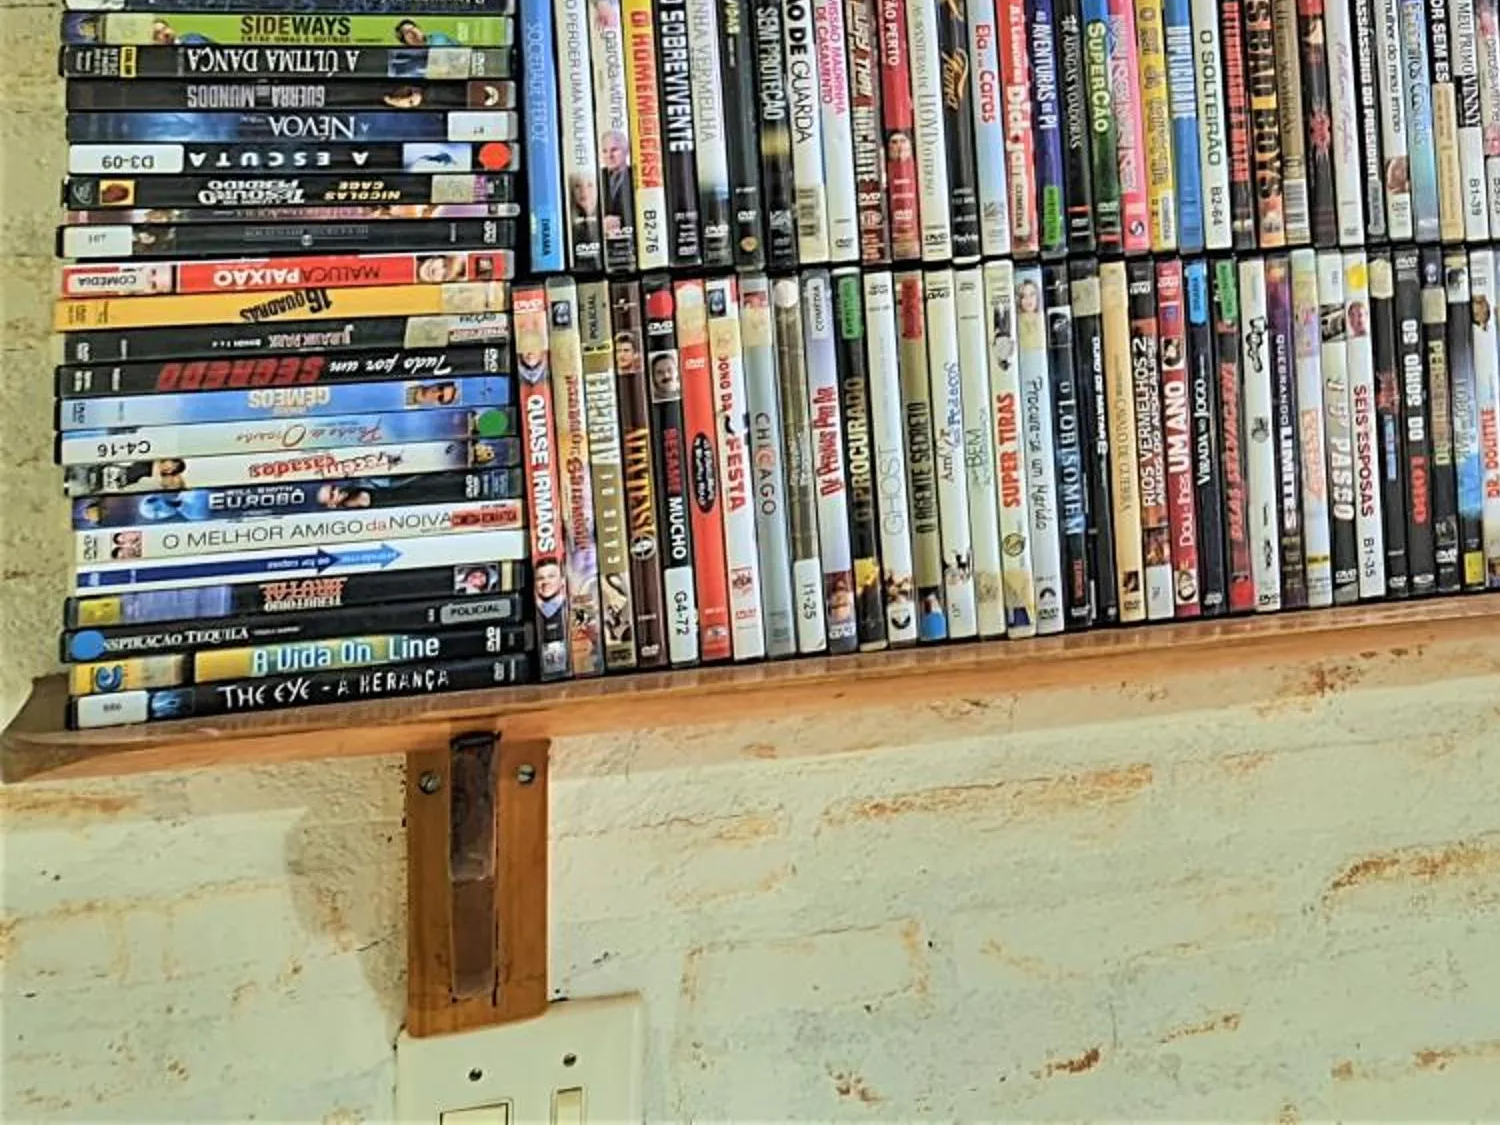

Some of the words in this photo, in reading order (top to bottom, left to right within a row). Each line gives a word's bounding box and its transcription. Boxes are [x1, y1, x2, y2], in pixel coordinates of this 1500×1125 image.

[240, 16, 351, 36] SIDEWAYS
[566, 13, 582, 68] PERDER
[755, 7, 777, 44] SEM
[789, 26, 809, 57] DE
[1199, 30, 1214, 45] O
[1433, 22, 1446, 57] SEM
[188, 47, 264, 73] DANÇA
[267, 48, 340, 74] ÚLTIMA
[344, 50, 360, 72] A
[1031, 24, 1056, 102] AVENTURAS
[186, 84, 257, 108] MUNDOS
[271, 84, 325, 108] GUERRA
[662, 10, 693, 152] SOBREVIVENTE
[790, 60, 814, 144] GUARDA
[1202, 51, 1223, 167] SOLTEIRÃO
[572, 107, 588, 166] MULHER
[101, 155, 154, 171] D3-09
[187, 150, 331, 167] ESCUTA
[322, 190, 401, 202] NICOLAS
[337, 179, 384, 191] CAGE
[643, 210, 658, 253] B2-76
[213, 267, 300, 290] PAIXÃO
[237, 297, 304, 323] QUADRAS
[302, 289, 332, 314] 16
[996, 391, 1016, 446] TIRAS
[1134, 356, 1153, 463] VERMELHOS
[1354, 385, 1370, 426] SEIS
[97, 440, 151, 457] C4-16
[527, 394, 547, 465] QUASE
[845, 377, 870, 501] PROCURADO
[725, 437, 746, 514] FESTA
[753, 411, 777, 516] CHICAGO
[1000, 450, 1022, 509] SUPER
[1280, 427, 1297, 531] LIMITES
[1356, 431, 1374, 518] ESPOSAS
[1143, 466, 1158, 507] RIOS
[190, 527, 284, 550] MELHOR
[291, 521, 364, 543] AMIGO
[388, 515, 453, 536] NOIVA
[530, 470, 558, 554] IRMÃOS
[667, 497, 687, 560] MUCHO
[673, 590, 689, 637] G4-72
